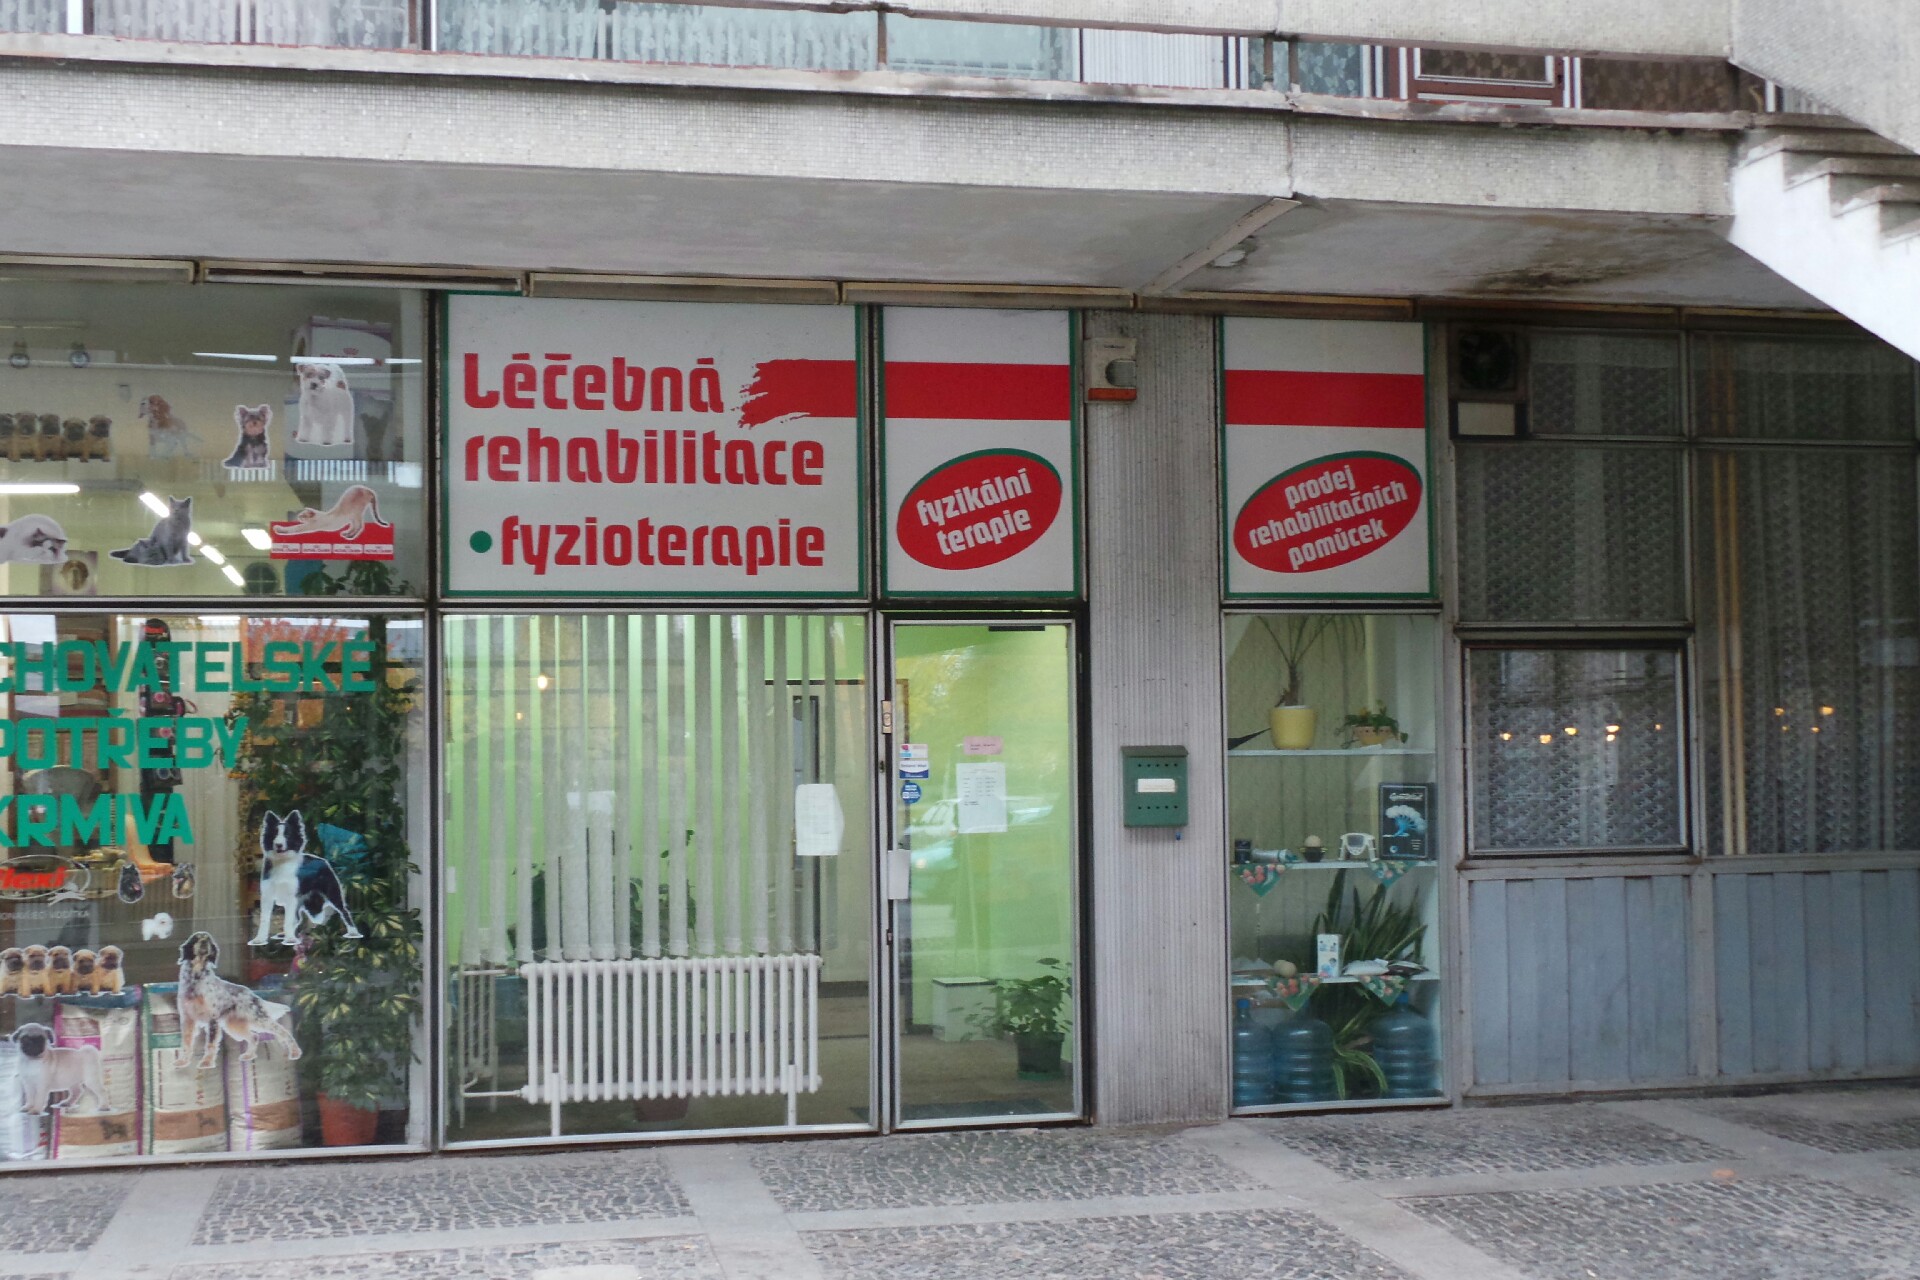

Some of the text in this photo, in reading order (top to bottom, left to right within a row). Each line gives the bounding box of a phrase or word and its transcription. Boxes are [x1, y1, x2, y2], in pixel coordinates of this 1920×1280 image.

[464, 352, 724, 414] Léčebná
[464, 427, 824, 486] rehabilitace
[916, 467, 1032, 527] fyzikální
[1248, 480, 1409, 549] rehabilitačních
[1284, 464, 1356, 510] prodej
[501, 515, 825, 576] fyzioterapie
[936, 508, 1032, 556] terapie
[1287, 518, 1389, 571] pomůcek
